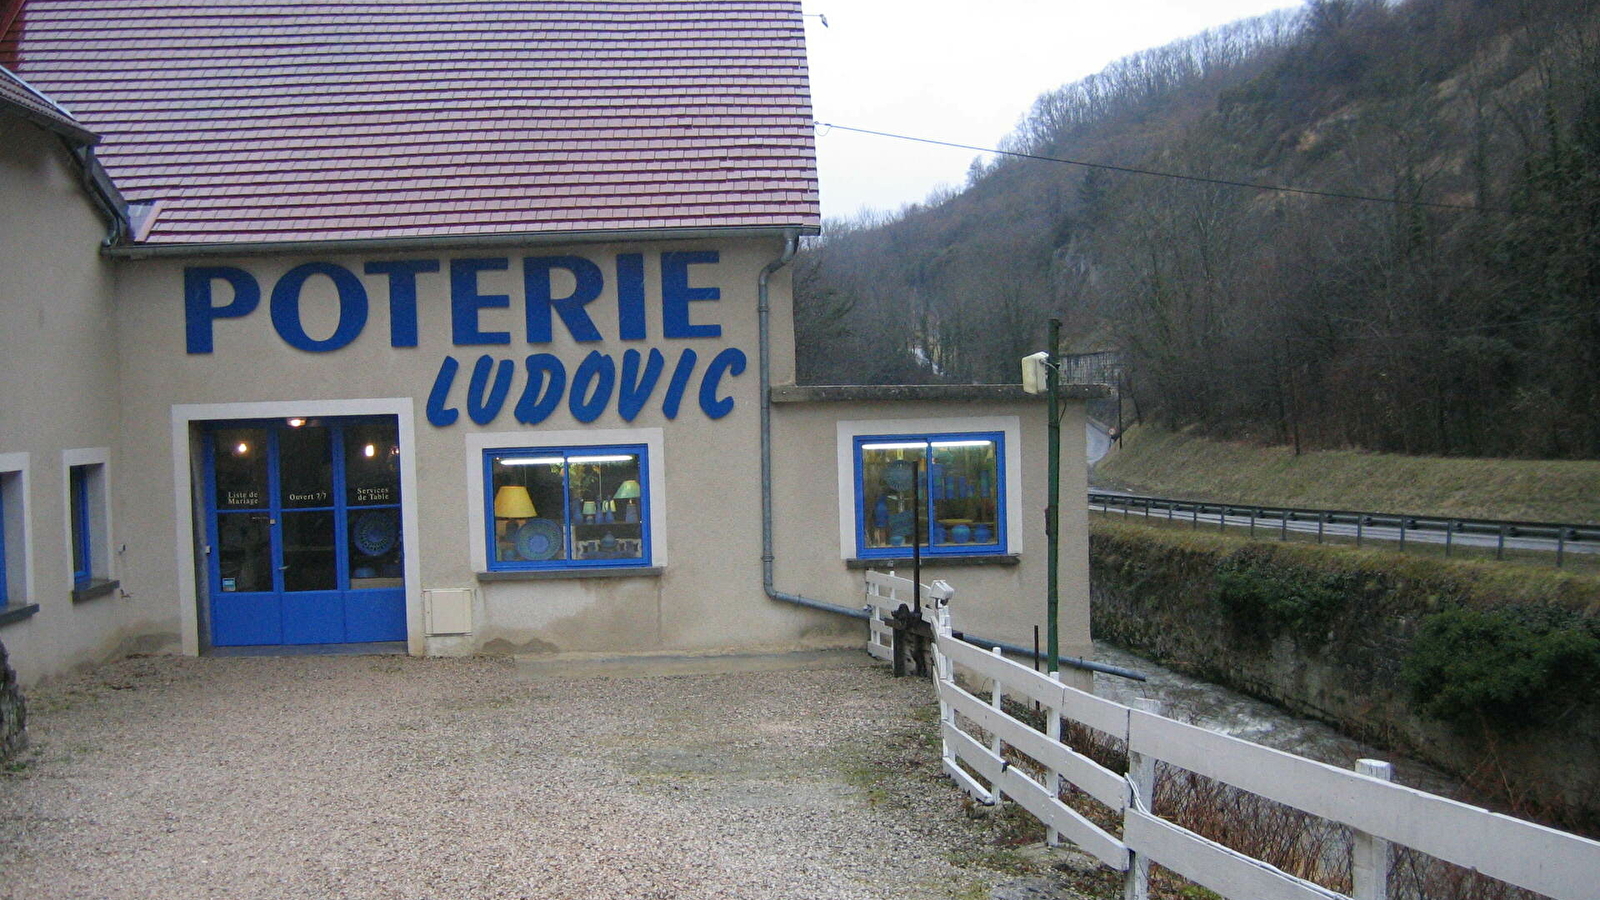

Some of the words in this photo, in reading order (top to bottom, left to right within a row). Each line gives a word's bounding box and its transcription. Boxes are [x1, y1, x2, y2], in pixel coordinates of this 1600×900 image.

[184, 251, 722, 354] POTERIE
[426, 347, 747, 427] LUDOVIC
[228, 491, 247, 499] Liste
[357, 487, 389, 495] Services
[289, 493, 314, 501] Ouvert
[228, 498, 258, 506] Mariage
